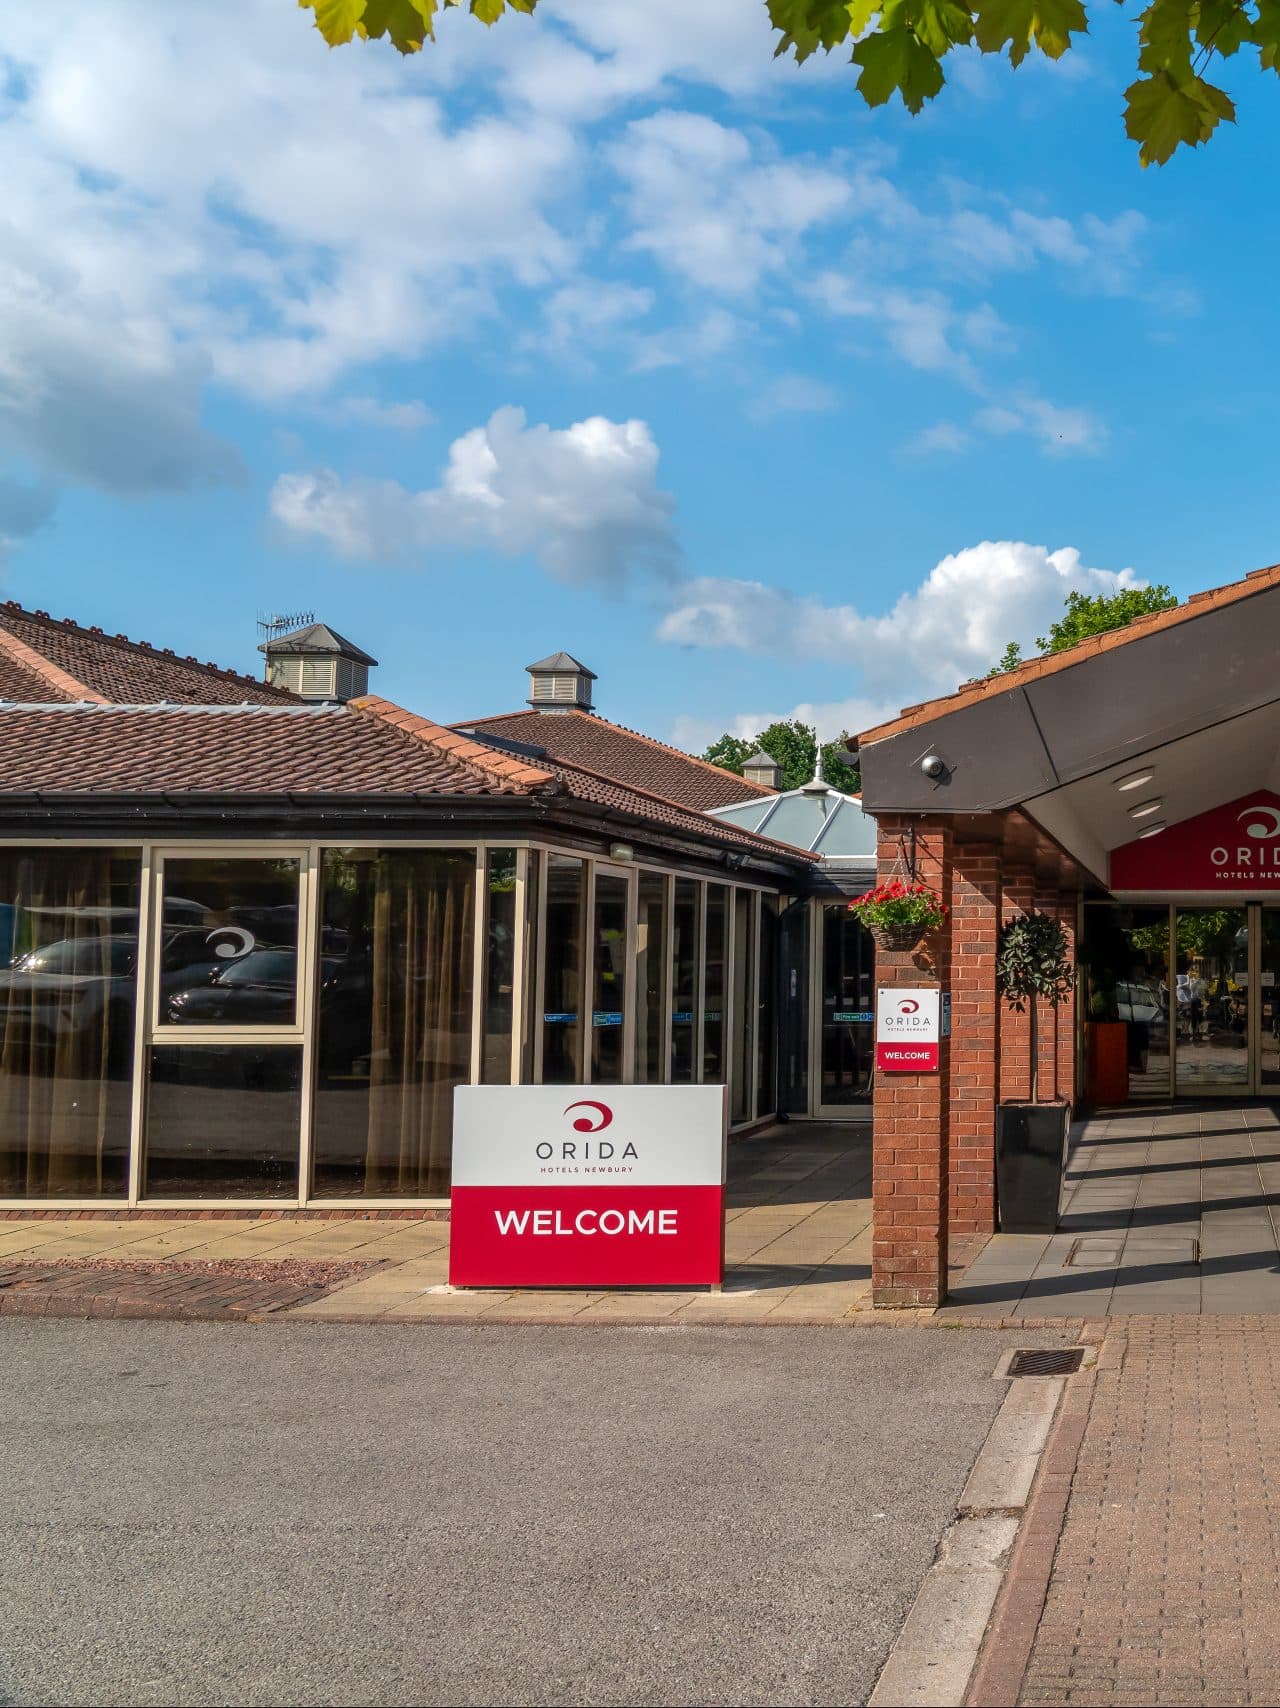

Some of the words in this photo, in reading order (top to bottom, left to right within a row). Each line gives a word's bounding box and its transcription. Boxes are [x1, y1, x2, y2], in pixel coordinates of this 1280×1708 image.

[885, 1017, 931, 1026] ORIDA
[884, 1051, 931, 1060] WELCOME
[535, 1142, 639, 1160] ORIDA
[494, 1209, 678, 1235] WELCOME
